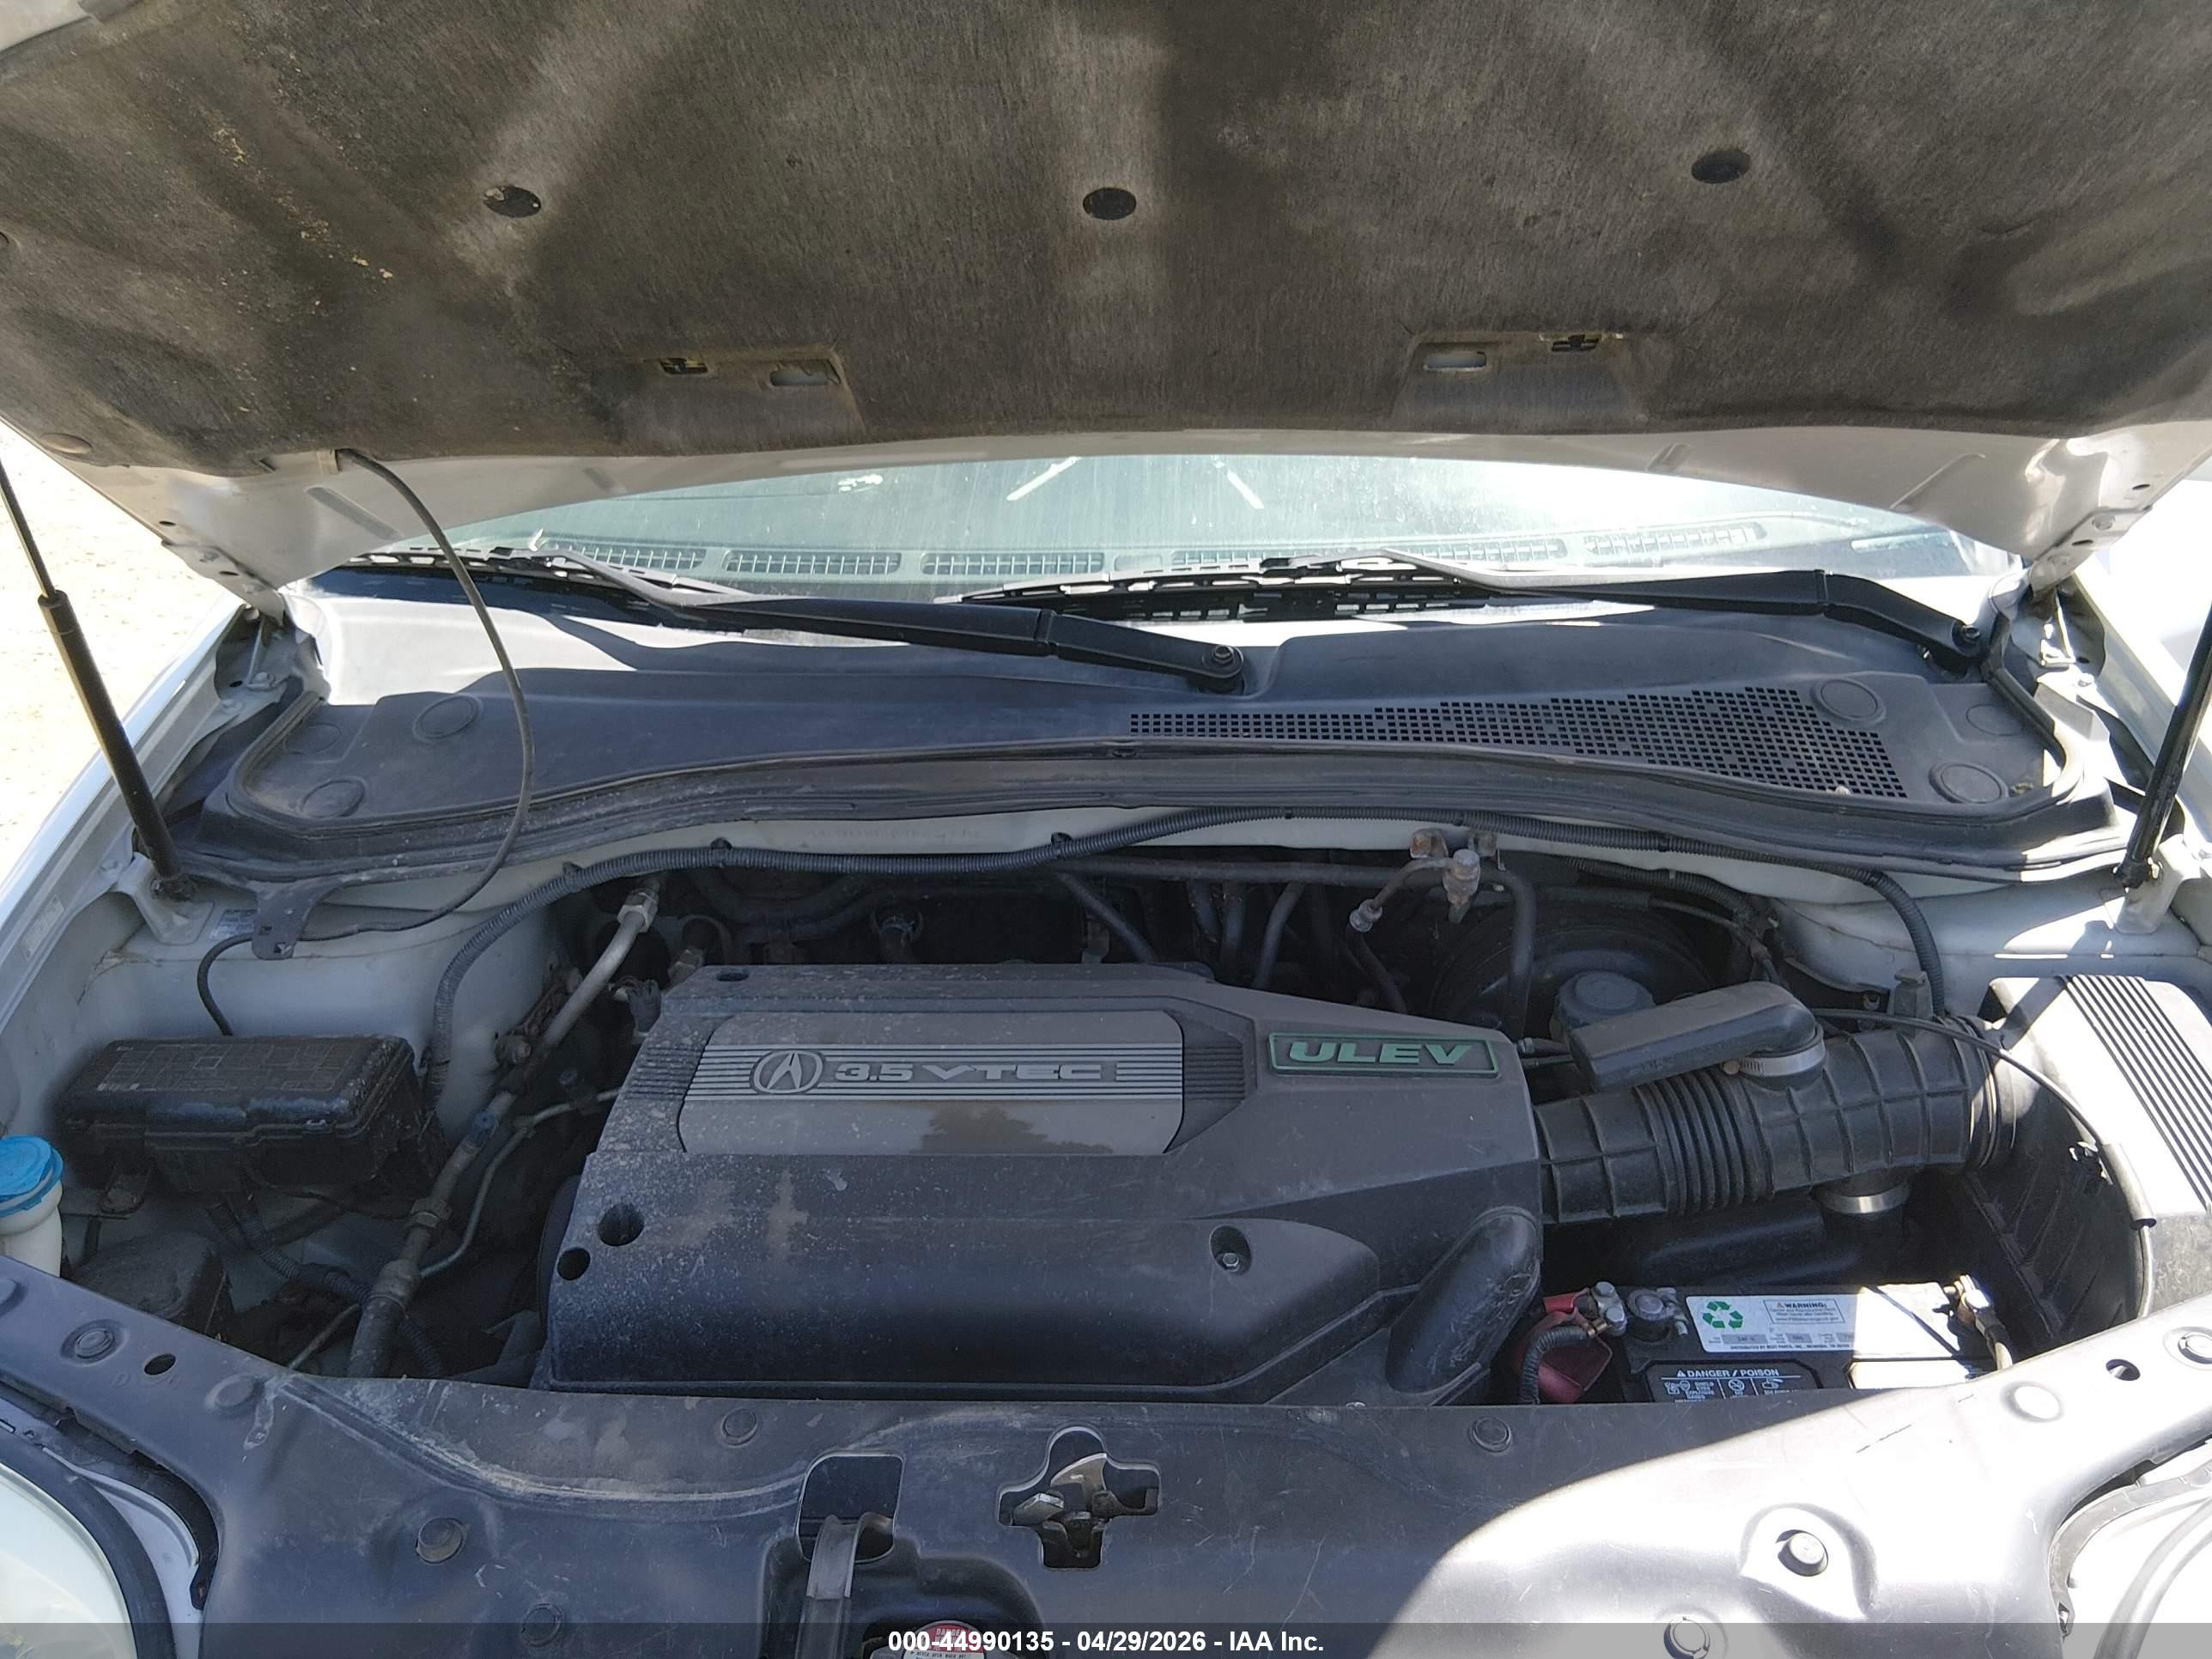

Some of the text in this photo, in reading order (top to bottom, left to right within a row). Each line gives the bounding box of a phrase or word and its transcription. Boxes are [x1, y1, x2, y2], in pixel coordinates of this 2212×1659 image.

[1289, 1041, 1473, 1066] ULEV
[836, 1062, 1102, 1083] 3.5 VTEC
[1740, 1368, 1780, 1376] POISON
